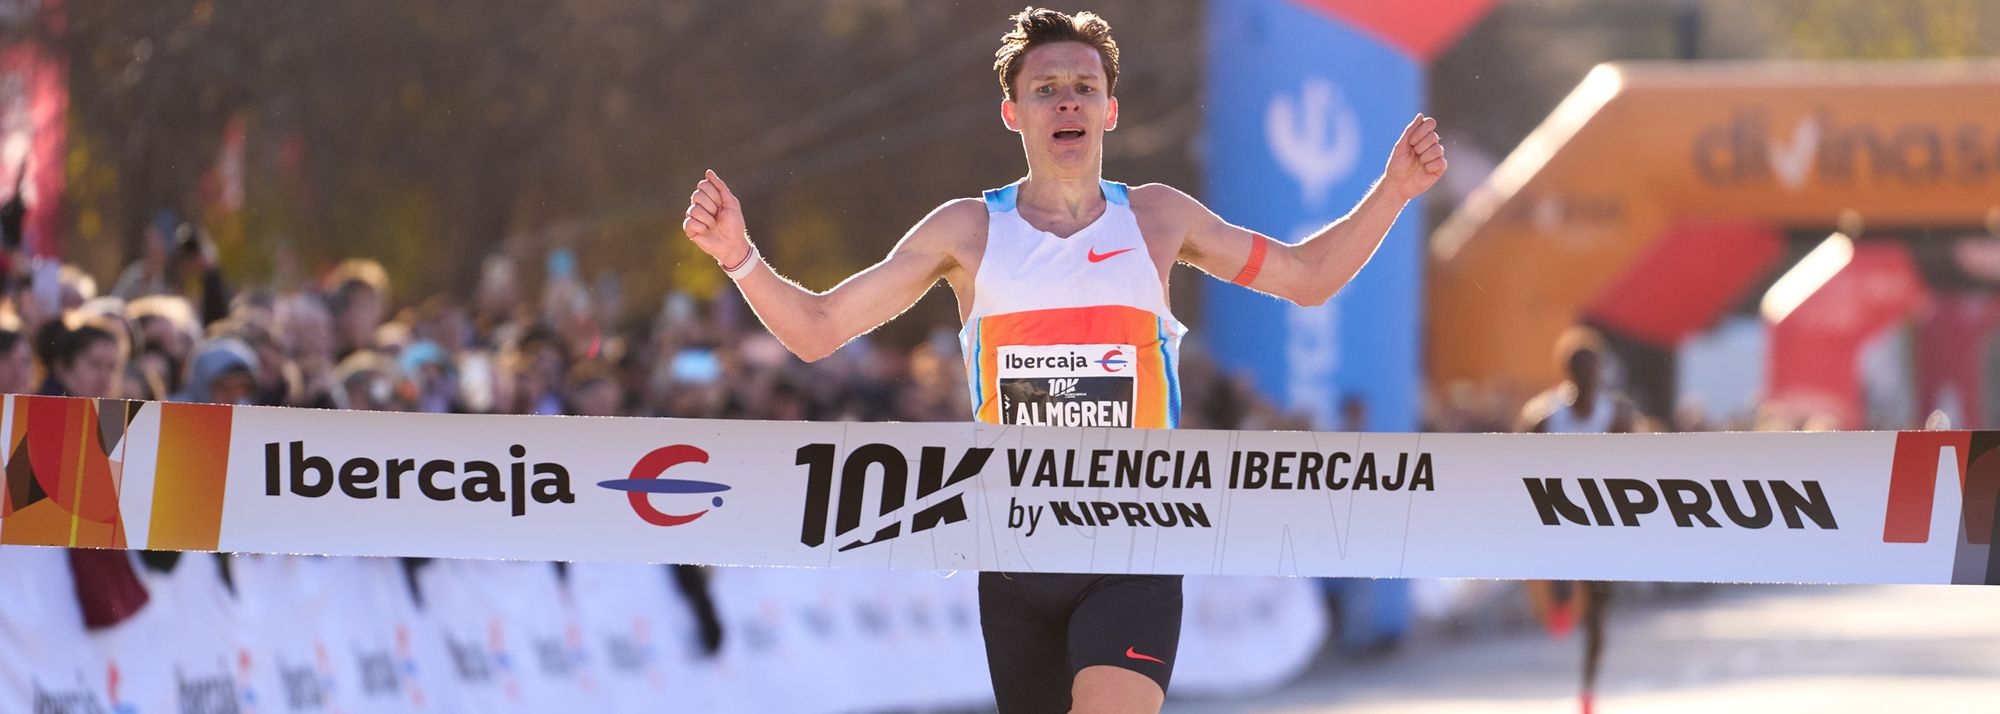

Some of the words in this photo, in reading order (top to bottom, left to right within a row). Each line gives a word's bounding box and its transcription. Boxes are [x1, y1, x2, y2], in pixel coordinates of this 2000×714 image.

[1005, 352, 1088, 372] Ibercaja
[1047, 378, 1080, 397] 10K
[1015, 400, 1128, 428] ALMGREN
[263, 440, 576, 517] Ibercaja
[1007, 448, 1212, 489] VALENCIA
[1228, 450, 1436, 491] IBERCAJA
[794, 443, 996, 553] 10K
[1007, 496, 1044, 537] by
[1049, 501, 1212, 528] KIPRUN
[1522, 477, 1840, 530] KIPRUN
